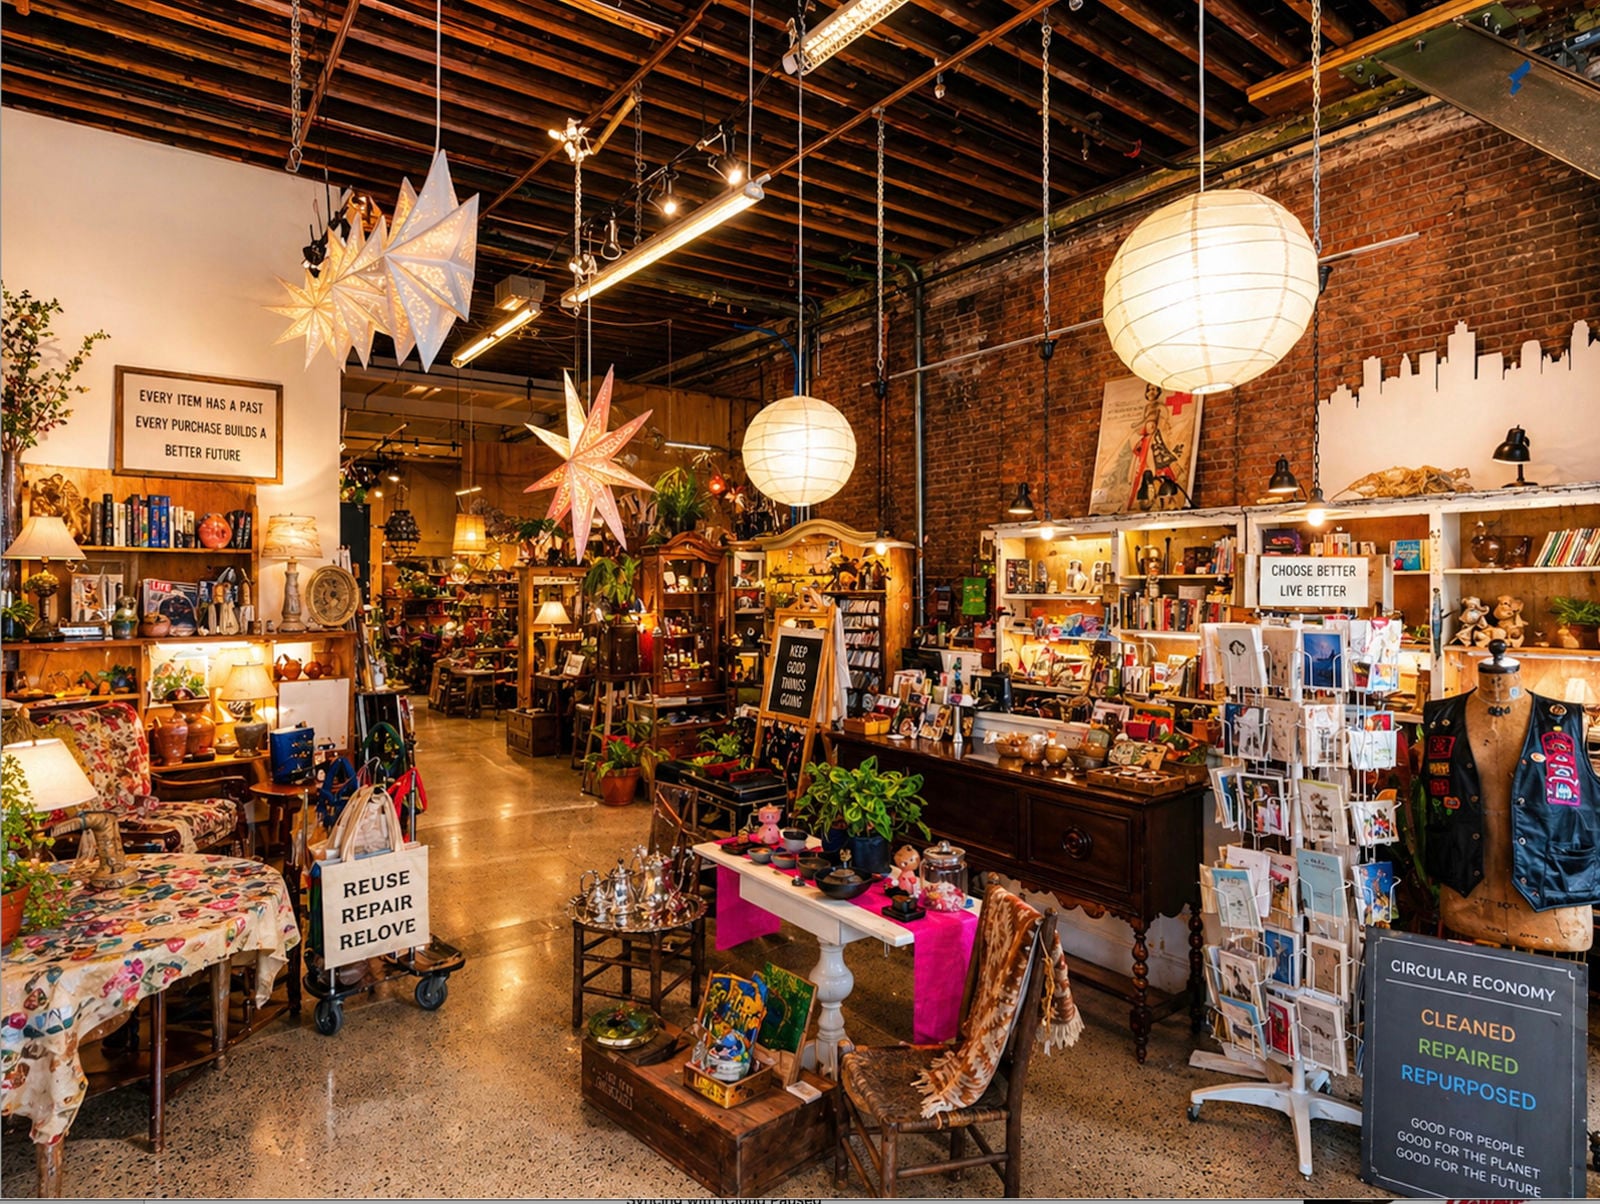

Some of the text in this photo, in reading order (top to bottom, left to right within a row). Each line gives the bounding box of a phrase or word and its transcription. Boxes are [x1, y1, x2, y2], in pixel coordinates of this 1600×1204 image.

[140, 390, 263, 414] EVERY ITEM HAS A PAST
[136, 416, 266, 438] EVERY PURCHASE BUILDS A
[166, 444, 240, 461] BETTER FUTURE
[1272, 565, 1356, 576] CHOOSE BETTER
[1281, 585, 1346, 597] LIVE BETTER
[789, 645, 808, 658] KEEP
[344, 870, 410, 898] REUSE
[342, 894, 413, 924] REPAIR
[340, 918, 416, 950] RELOVE
[1391, 960, 1555, 1002] CIRCULAR ECONOMY
[1421, 1009, 1515, 1043] CLEANED
[1418, 1038, 1518, 1075] REPAIRED
[1402, 1063, 1536, 1110] REPURPOSED
[1411, 1118, 1524, 1157] GOOD FOR PEOPLE
[1398, 1131, 1541, 1179] GOOD FOR THE PLANET
[1396, 1147, 1541, 1197] GOOD FOR THE FUTURE
